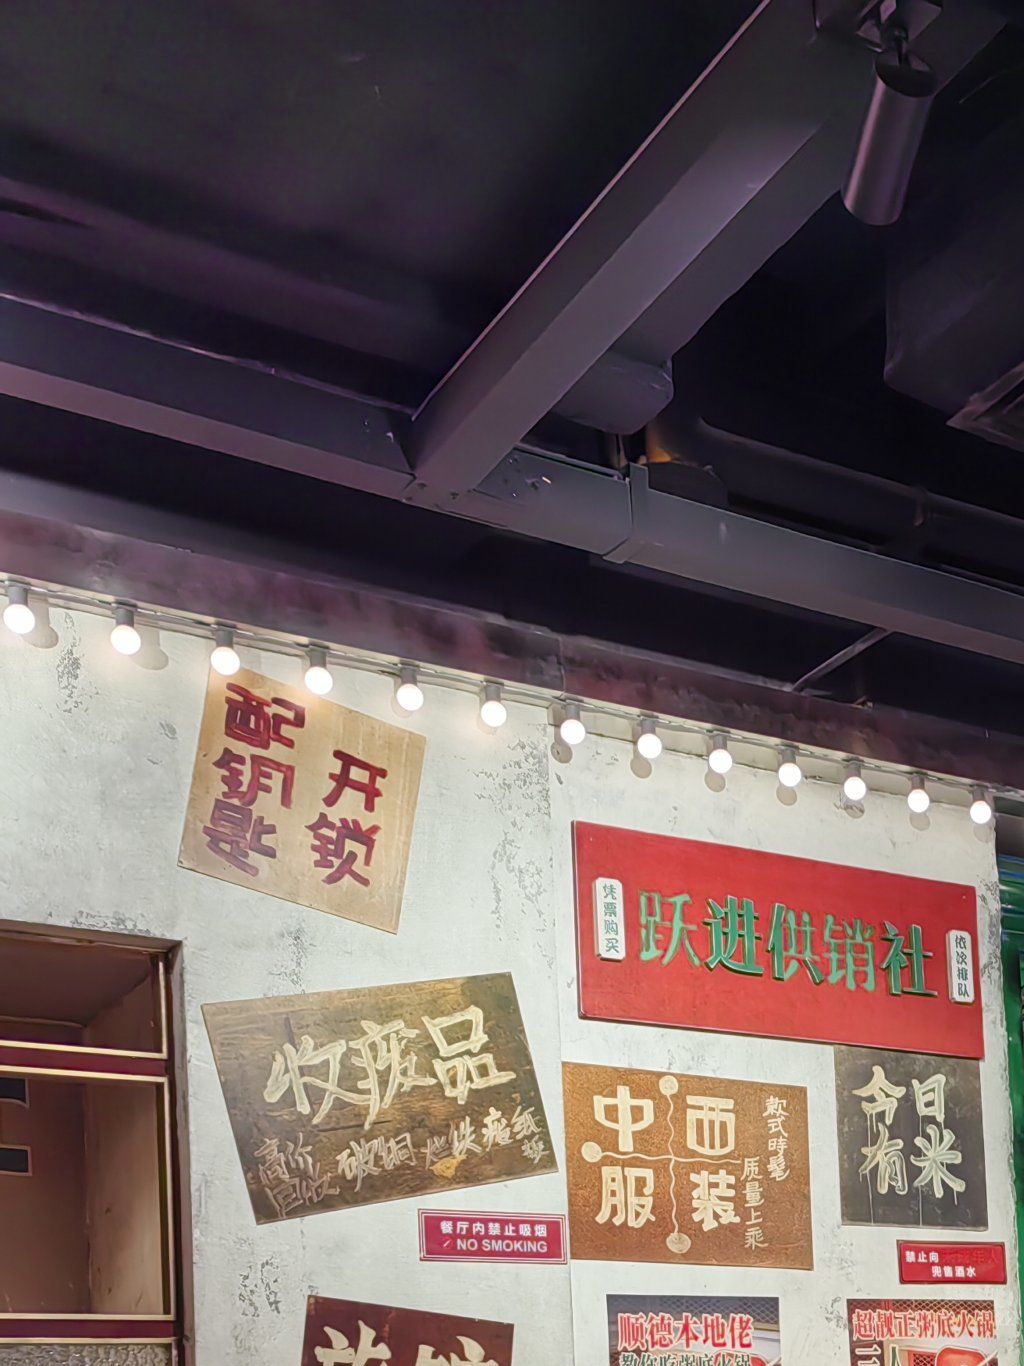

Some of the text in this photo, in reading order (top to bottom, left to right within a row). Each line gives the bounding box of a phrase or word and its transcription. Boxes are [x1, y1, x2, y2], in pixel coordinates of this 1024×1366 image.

[202, 682, 306, 877] 配钥匙
[304, 749, 388, 888] 开锁
[602, 883, 620, 954] 凭票购买
[638, 889, 938, 998] 跃进供销社
[954, 934, 970, 999] 依次排队
[262, 1005, 517, 1130] 收废品
[852, 1065, 947, 1126] 今日
[859, 1122, 966, 1199] 有米
[440, 1220, 547, 1237] 餐厅内禁止吸烟
[456, 1238, 548, 1253] NO SMOKING
[931, 1265, 977, 1278] 兜售酒水
[617, 1312, 753, 1351] 顺德本地佬
[852, 1309, 996, 1340] 超靓正粥底火锅
